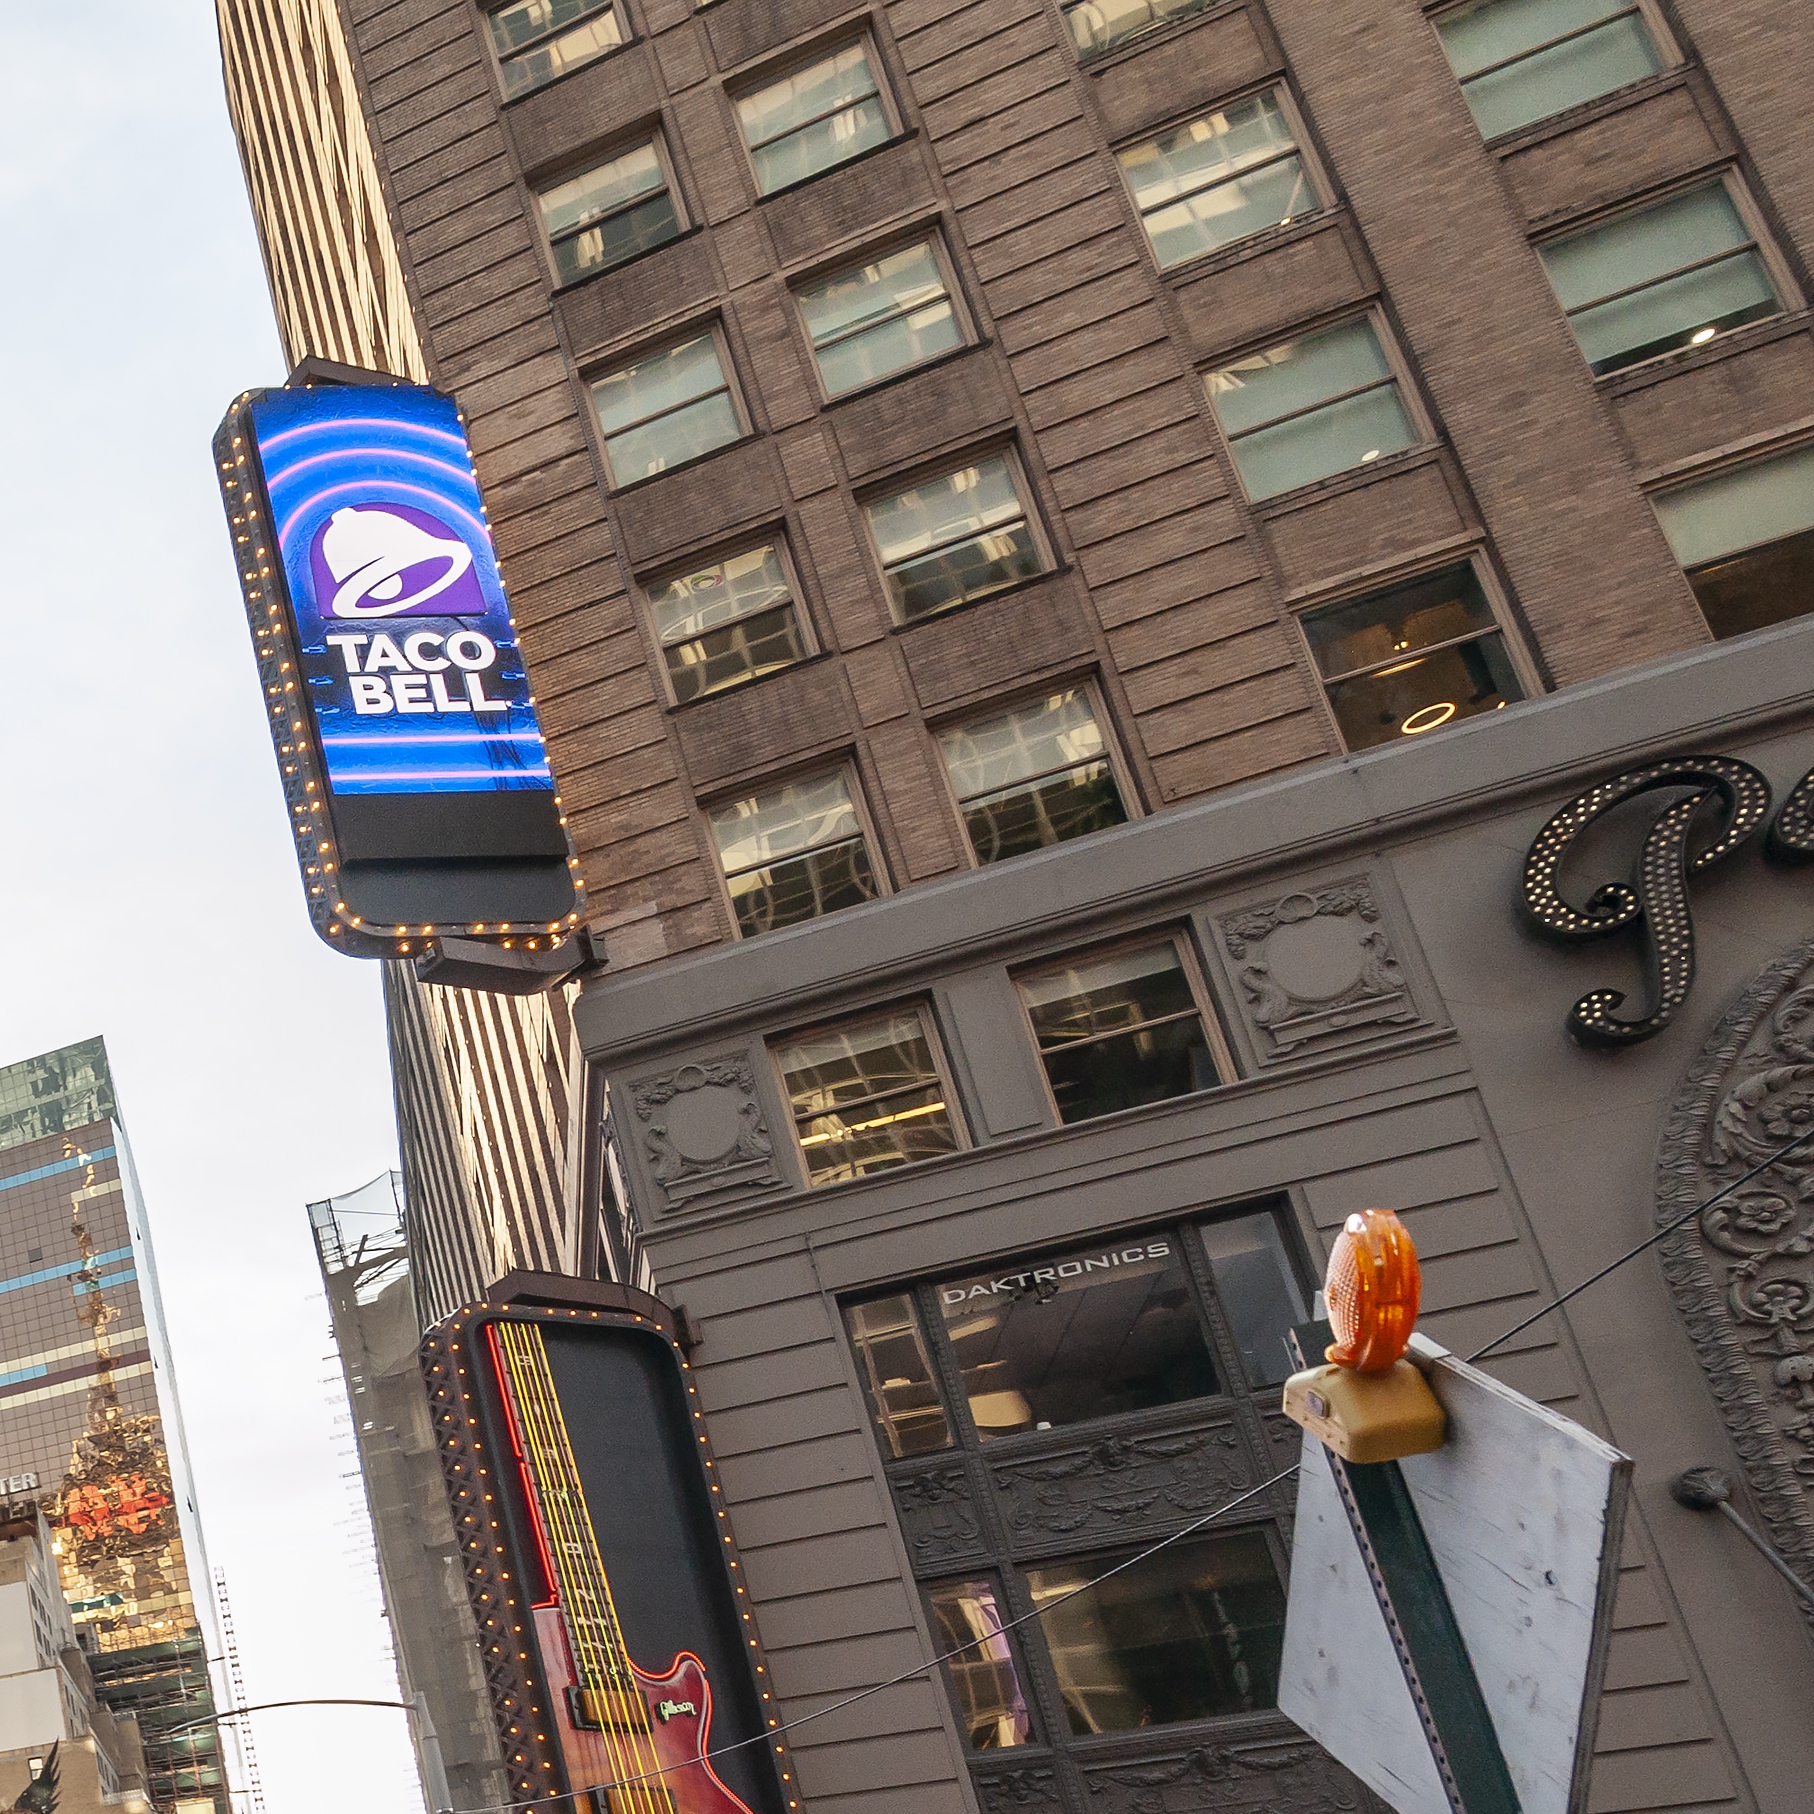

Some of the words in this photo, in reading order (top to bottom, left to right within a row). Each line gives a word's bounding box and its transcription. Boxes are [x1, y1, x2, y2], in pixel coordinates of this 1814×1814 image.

[326, 630, 497, 674] TACO
[348, 674, 508, 716] BELL
[1521, 752, 1814, 1047] P
[943, 1242, 1171, 1305] DAKTRONICS
